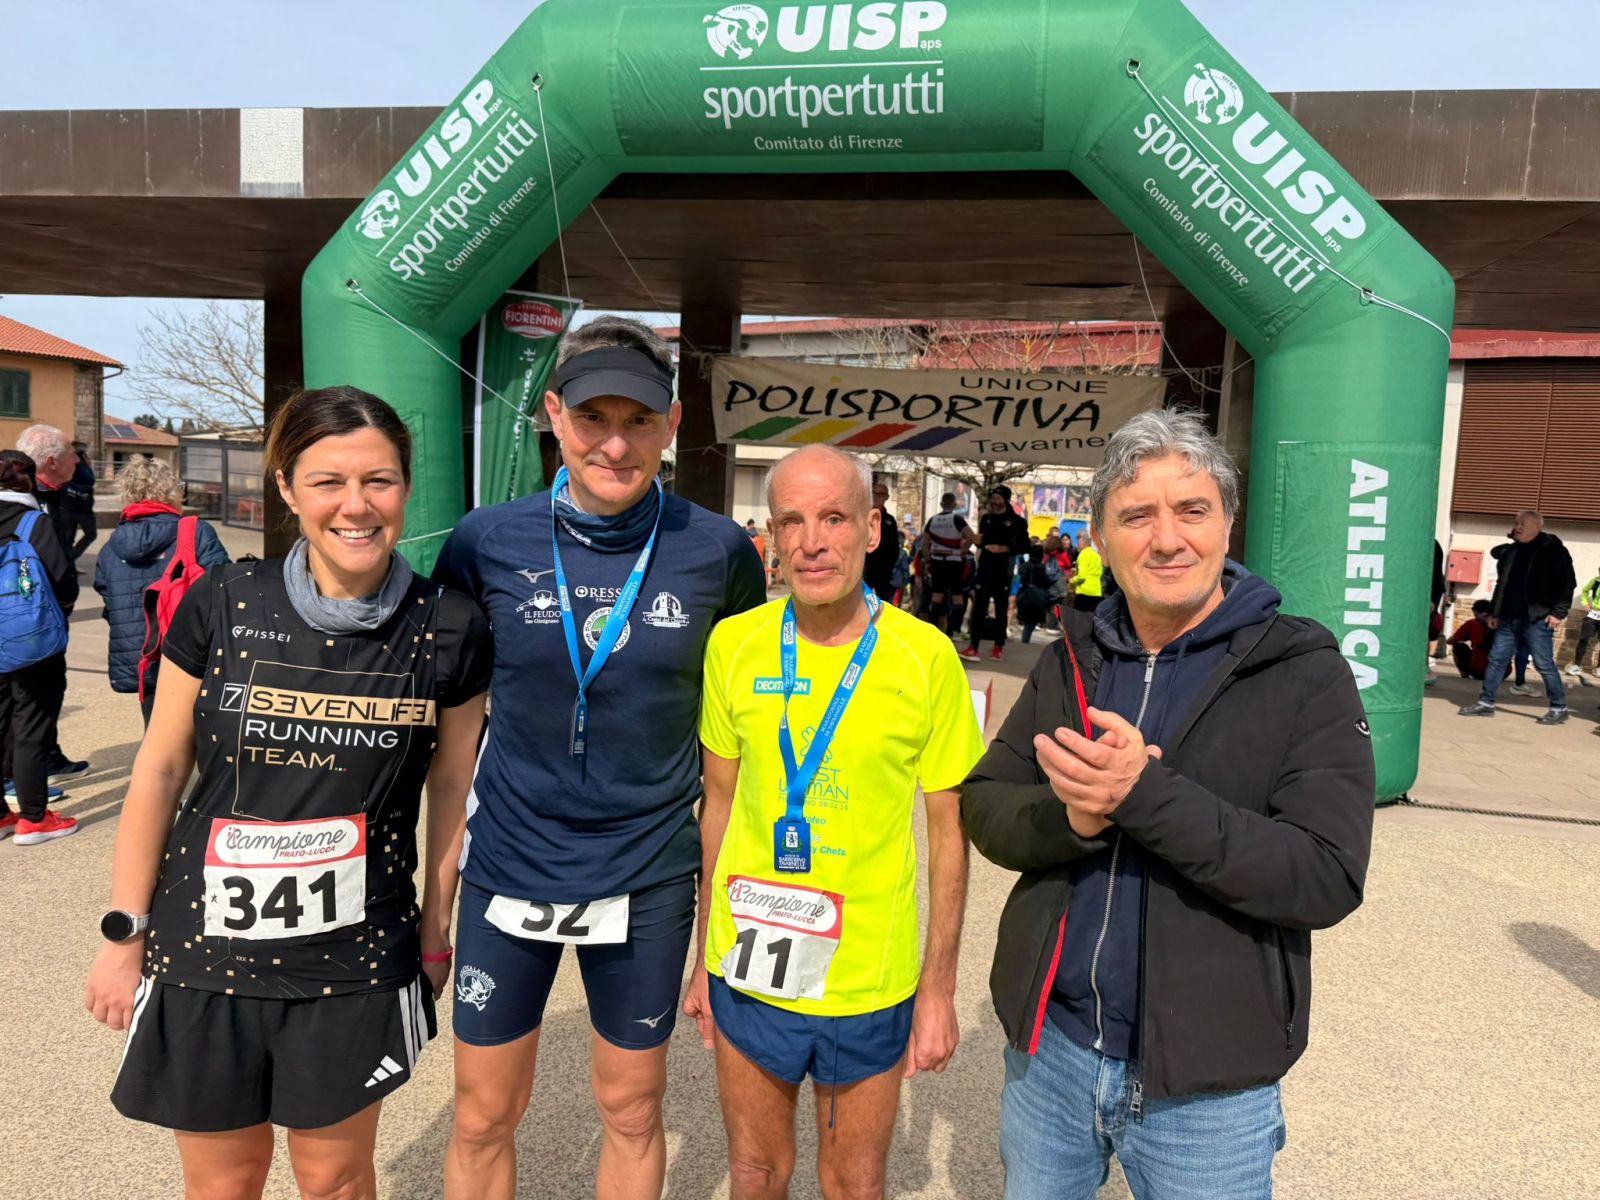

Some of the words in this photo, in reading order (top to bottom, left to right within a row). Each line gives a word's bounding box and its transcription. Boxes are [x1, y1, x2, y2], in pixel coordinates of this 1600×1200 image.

[776, 1, 947, 53] UISP
[920, 38, 942, 50] aps
[488, 98, 503, 115] aps
[703, 68, 944, 129] sportpertutti
[395, 79, 494, 197] UISP
[754, 136, 824, 150] Comitato
[829, 136, 843, 149] di
[848, 135, 903, 148] Firenze
[1232, 111, 1366, 239] UISP
[389, 110, 539, 281] sportpertutti
[1133, 113, 1326, 294] sportpertutti
[444, 226, 491, 272] Comitato
[489, 211, 503, 227] di
[497, 176, 537, 216] Firenze
[1142, 177, 1194, 232] Comitato
[1194, 231, 1211, 246] di
[1207, 242, 1249, 288] Firenze
[1324, 233, 1342, 253] aps
[505, 311, 561, 327] FIORENTINI
[960, 376, 1108, 394] UNIONE
[724, 379, 1100, 431] POLISPORTIVA
[1341, 458, 1389, 691] ATLETICA
[533, 610, 561, 619] FEUDO
[245, 629, 291, 643] PISSEI
[224, 687, 243, 707] 7
[756, 681, 807, 693] DECATON
[245, 719, 399, 749] RUNNING
[226, 827, 348, 860] Campione
[279, 845, 336, 858] PRATO-LUCCA
[222, 870, 337, 931] 341
[772, 910, 816, 925] PRATO-LUCCA
[734, 927, 793, 990] 11
